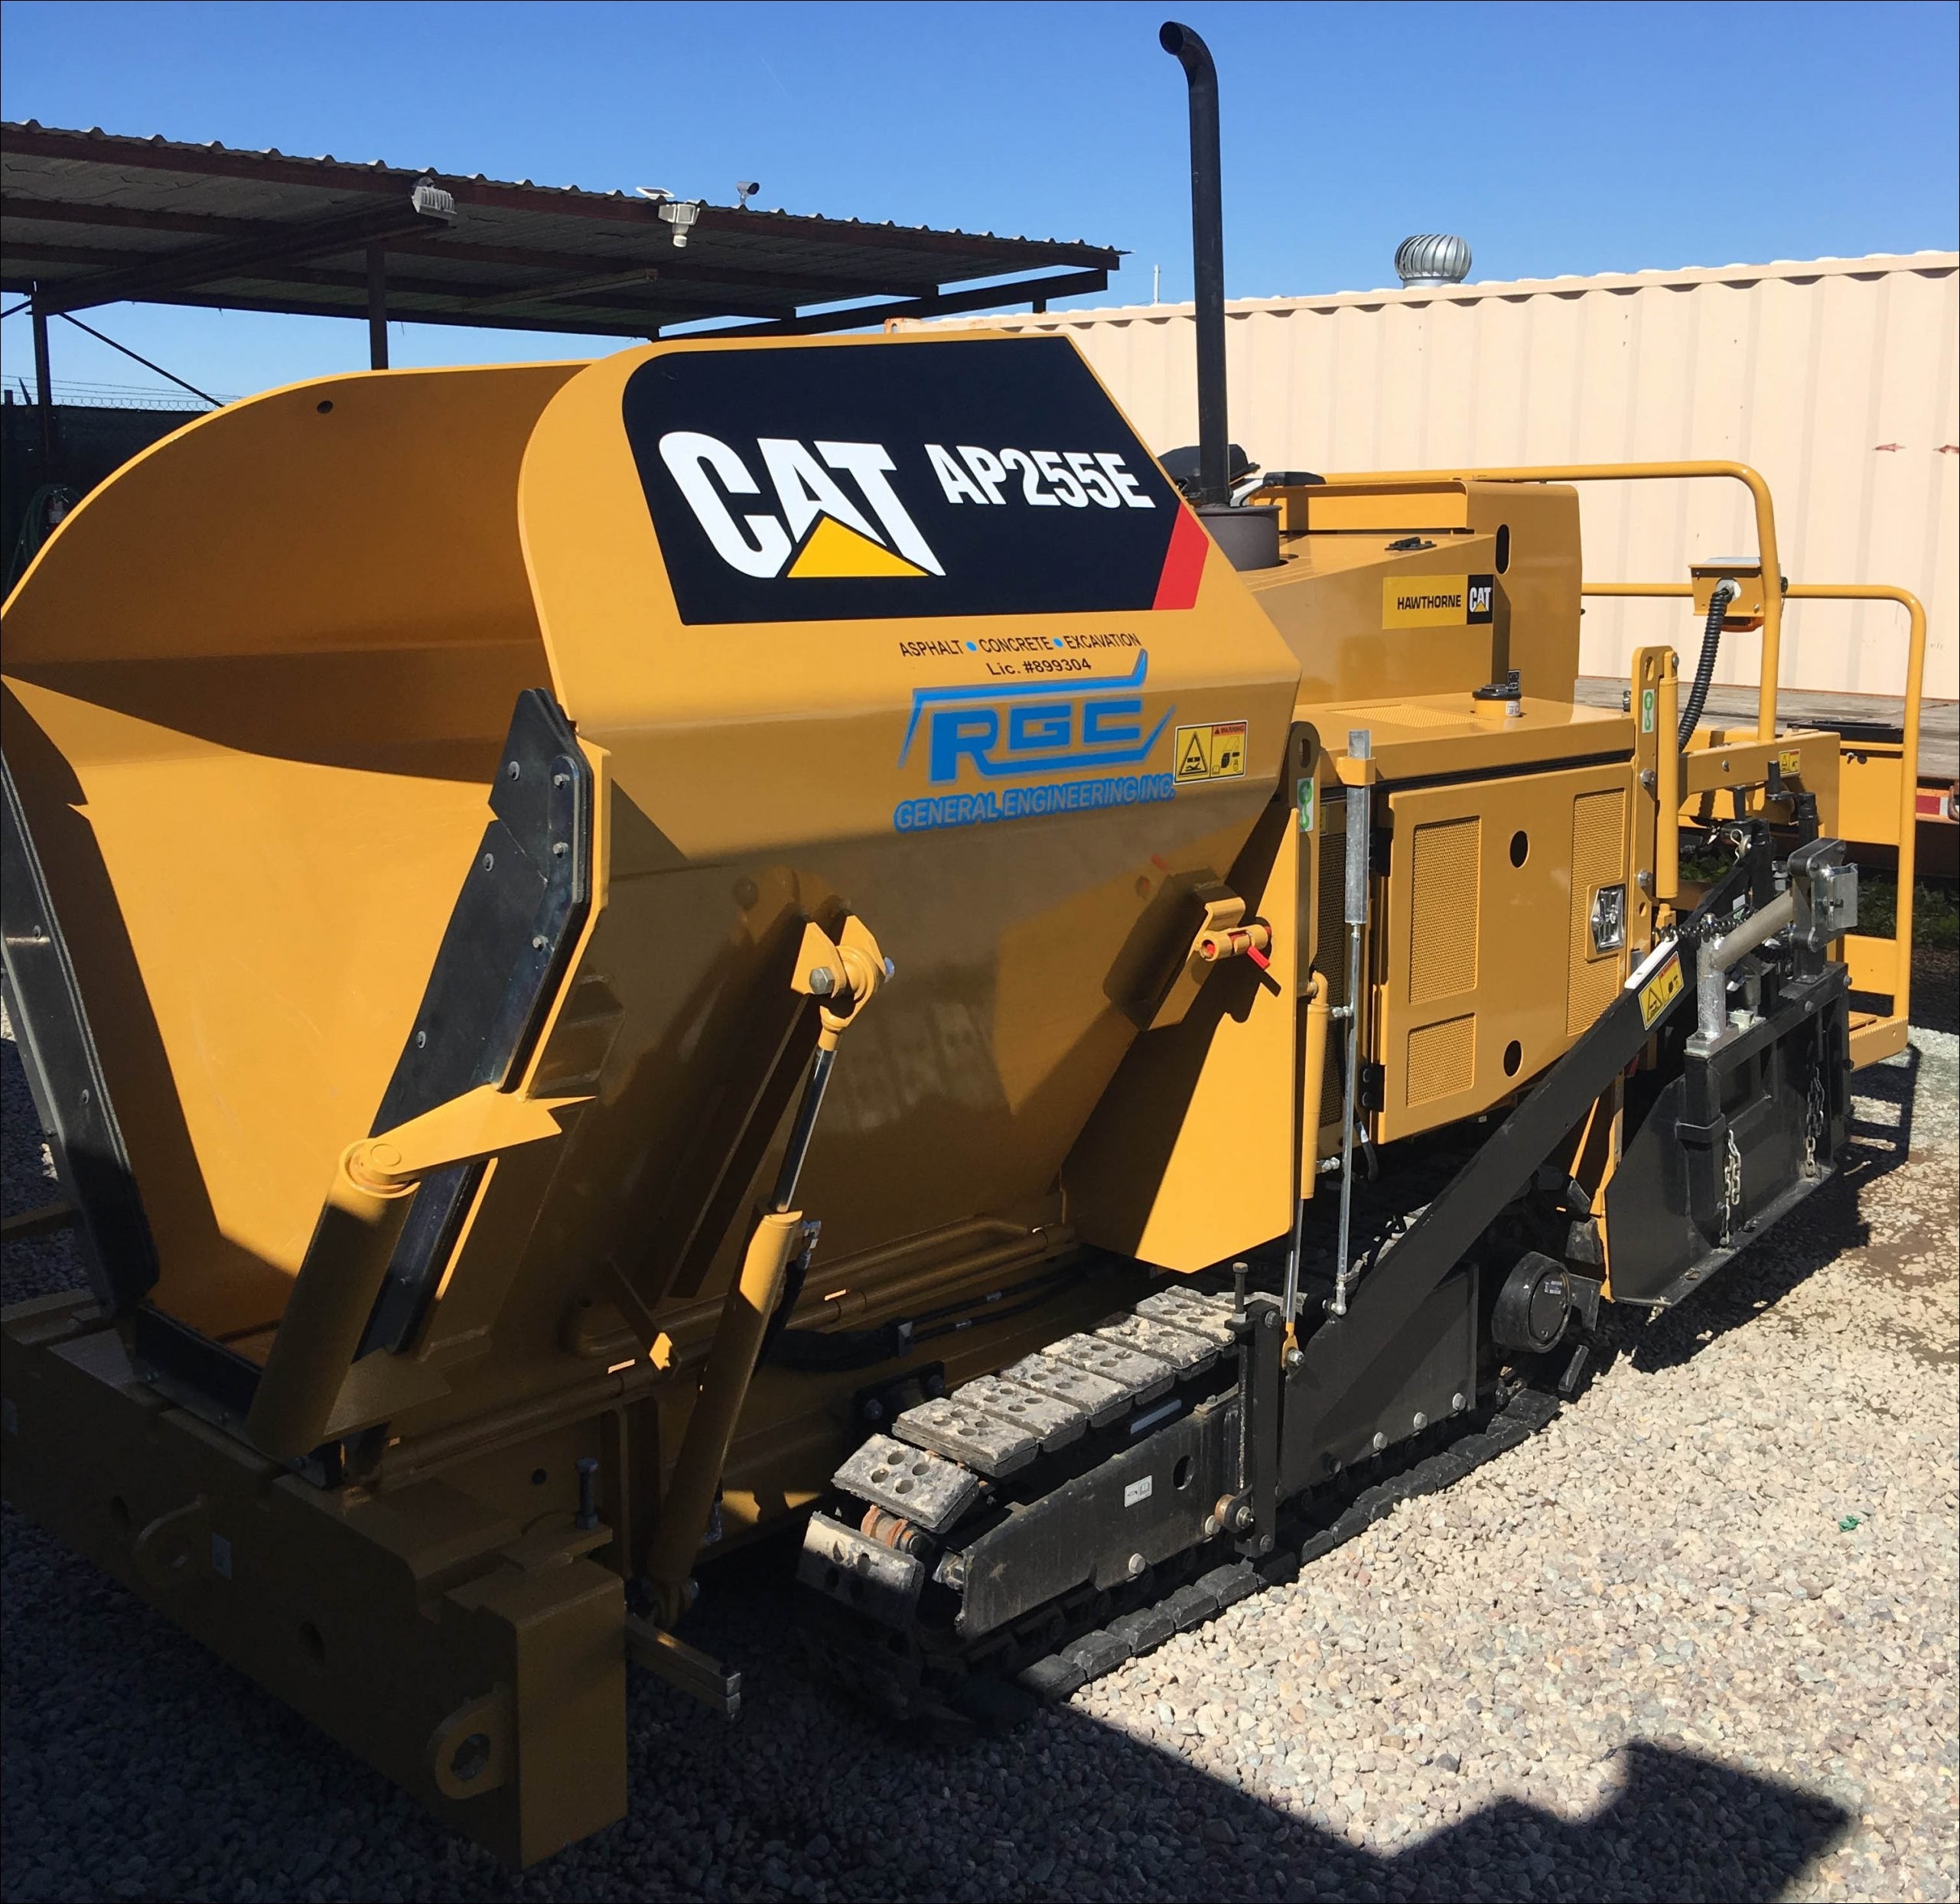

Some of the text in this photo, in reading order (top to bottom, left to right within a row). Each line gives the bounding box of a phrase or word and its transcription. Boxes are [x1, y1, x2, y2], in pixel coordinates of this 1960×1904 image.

[924, 444, 1156, 508] AP255E
[659, 431, 946, 578] CAT
[1397, 595, 1461, 610] HAWTHORNE
[1469, 587, 1491, 612] CAT
[899, 633, 1141, 657] ASPHALT CONCRETE EXCAVATION
[986, 658, 1092, 675] Lic. #899304
[930, 699, 1143, 783] RGC
[897, 775, 1174, 828] GENERAL ENGINEERING INC.
